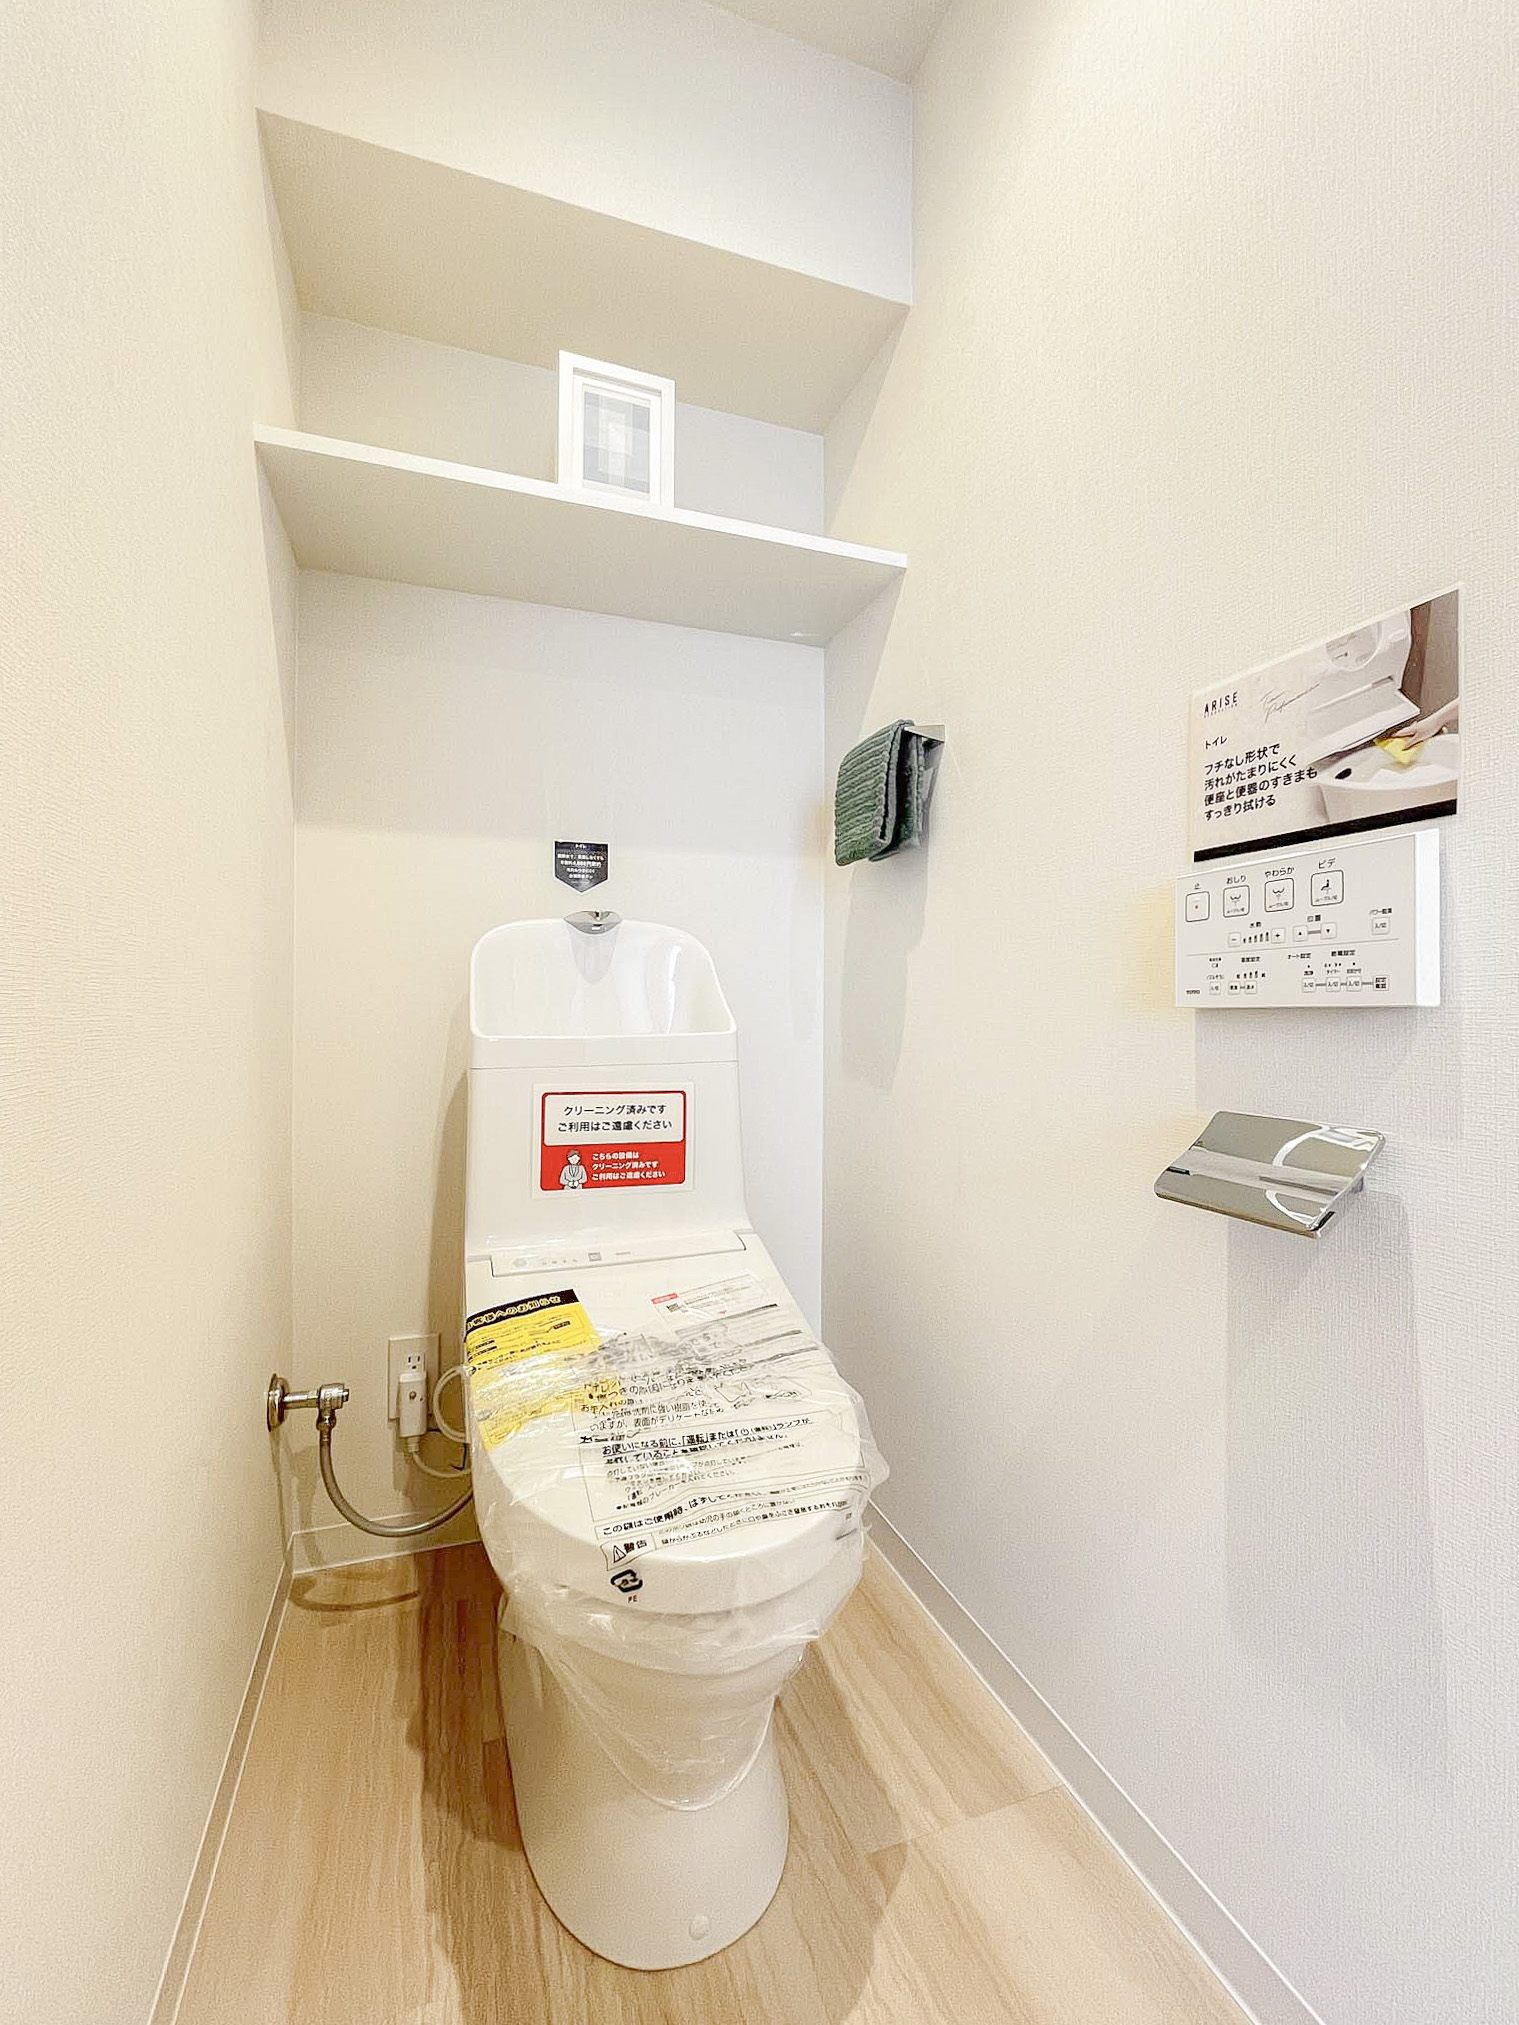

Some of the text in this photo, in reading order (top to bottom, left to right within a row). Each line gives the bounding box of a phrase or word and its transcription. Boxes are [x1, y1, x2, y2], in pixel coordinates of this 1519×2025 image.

[1203, 691, 1238, 714] ARISE
[1205, 736, 1228, 750] トイレ
[1204, 743, 1280, 775] フチなし形状で
[1204, 754, 1297, 791] 汚れがたまりにくく
[1204, 767, 1318, 807] 便座と便器のすきまも
[1204, 794, 1276, 821] すっきり拭ける
[1318, 858, 1336, 869] ビデ
[1265, 866, 1295, 878] やわらか
[1226, 875, 1247, 884] おしり
[564, 1104, 667, 1116] クリーニング済みです
[558, 1120, 673, 1132] ご利用はご遠慮ください
[592, 1151, 639, 1161] こちらの設備は
[592, 1160, 659, 1171] クリーニング済みです
[591, 1171, 666, 1181] ご利用はご遠慮ください
